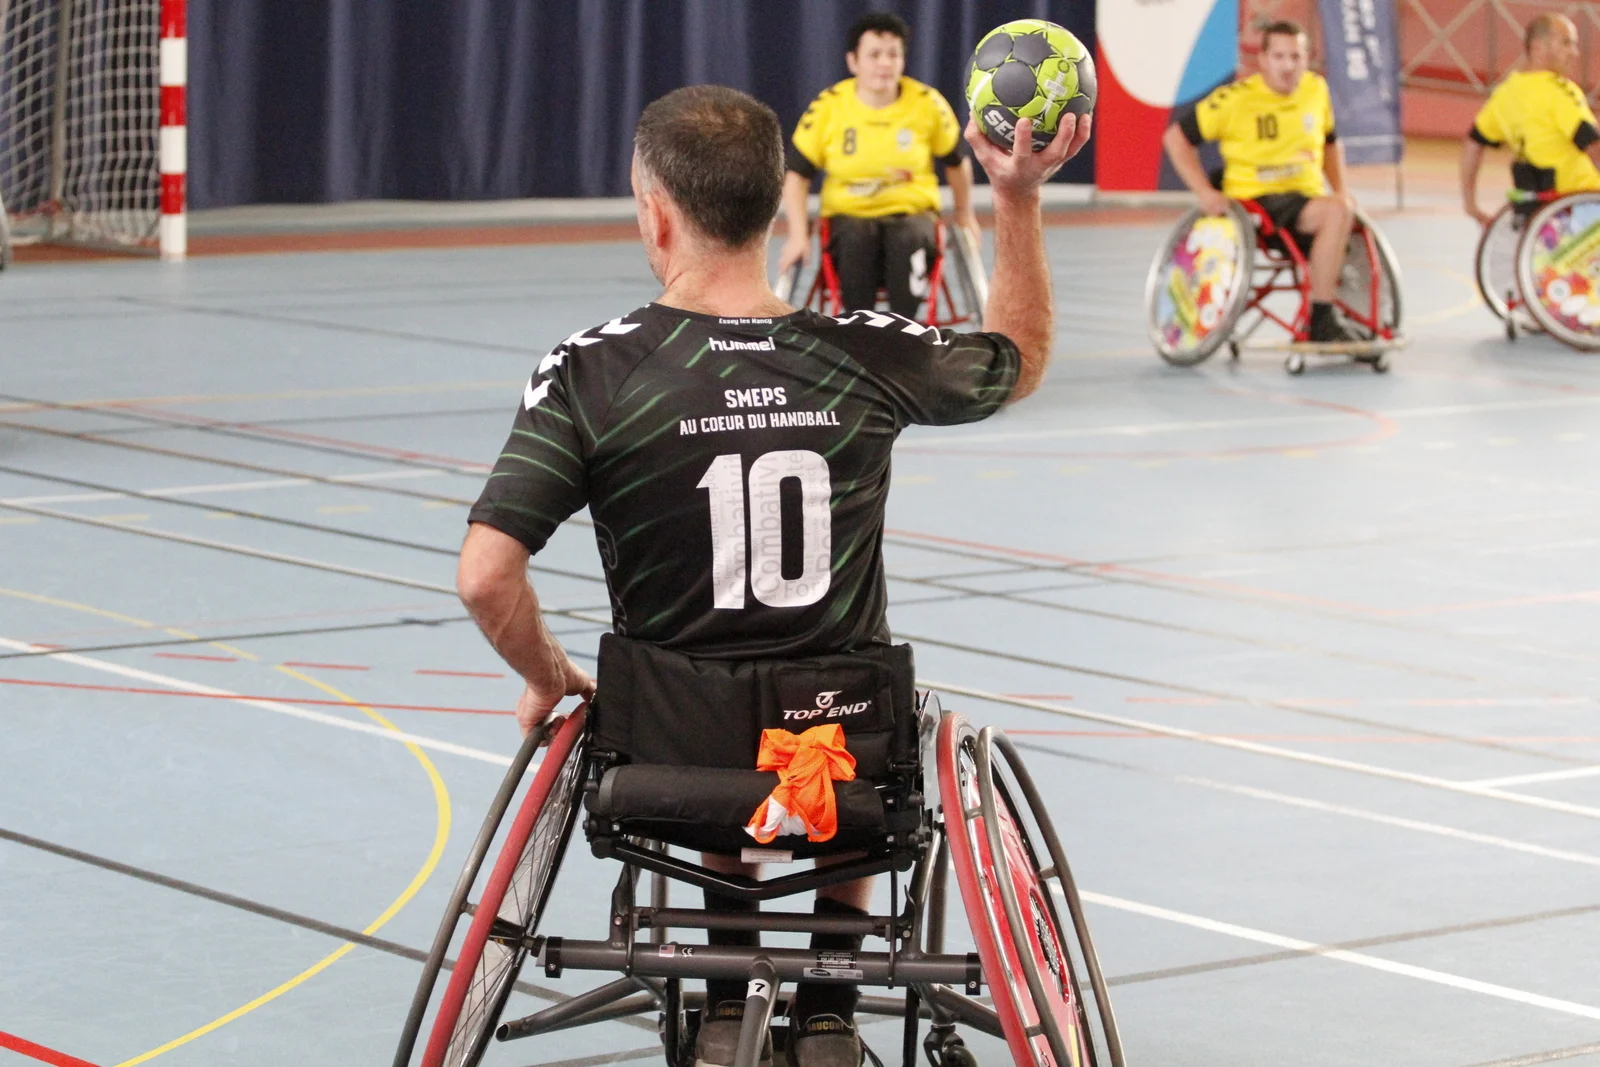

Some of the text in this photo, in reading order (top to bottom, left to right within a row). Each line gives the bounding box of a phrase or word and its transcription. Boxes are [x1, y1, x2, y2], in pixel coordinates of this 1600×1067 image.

[1256, 113, 1279, 141] 10
[842, 127, 857, 156] 8
[708, 336, 776, 351] hummel
[724, 386, 788, 409] SMEPS
[679, 411, 841, 436] AU COEUR DU HANDBALL
[695, 449, 832, 610] 10
[783, 701, 868, 720] TOP END
[754, 982, 766, 993] 7
